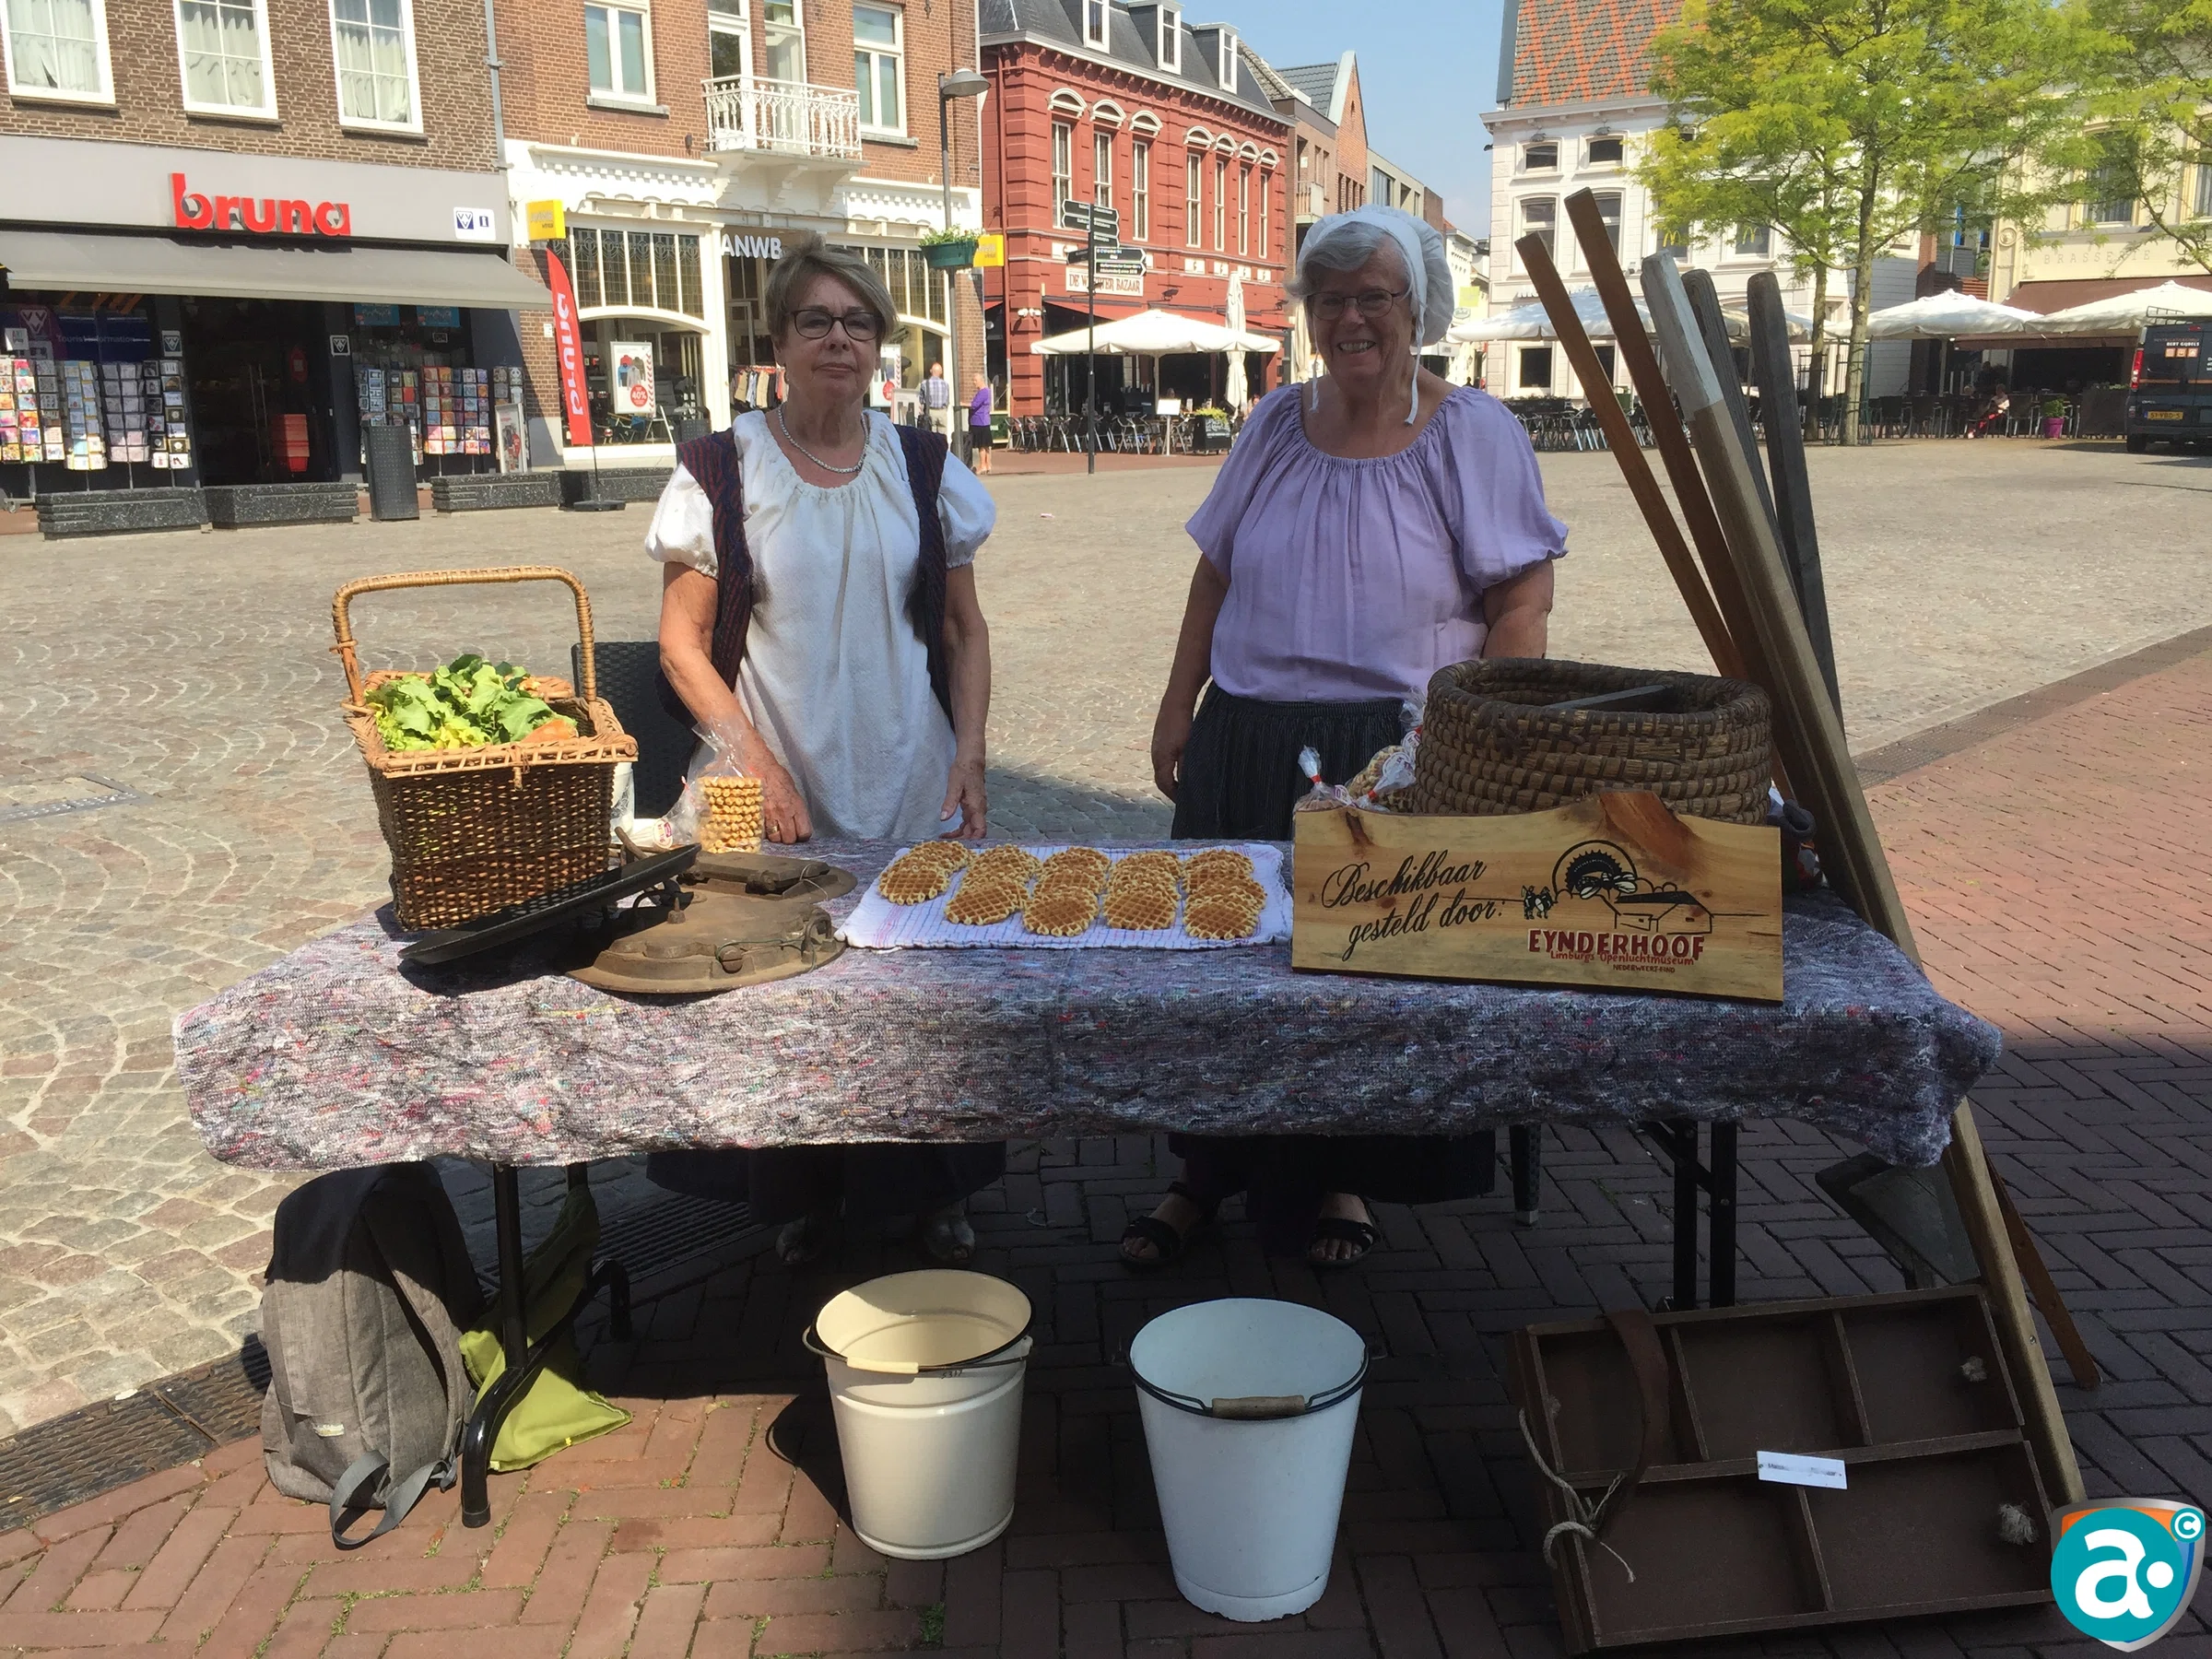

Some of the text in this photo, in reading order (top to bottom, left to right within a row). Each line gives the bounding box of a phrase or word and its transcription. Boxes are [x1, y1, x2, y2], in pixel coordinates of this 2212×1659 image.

[170, 172, 351, 236] bruna
[721, 233, 783, 260] ANWB
[1069, 274, 1079, 287] DE
[1116, 278, 1140, 293] BAZAAR
[1322, 849, 1487, 908] Beschikbaar
[1342, 888, 1506, 961] gesteld door:
[1528, 928, 1704, 960] EYNDERHOOF
[1599, 952, 1695, 966] Openluchtmuseum
